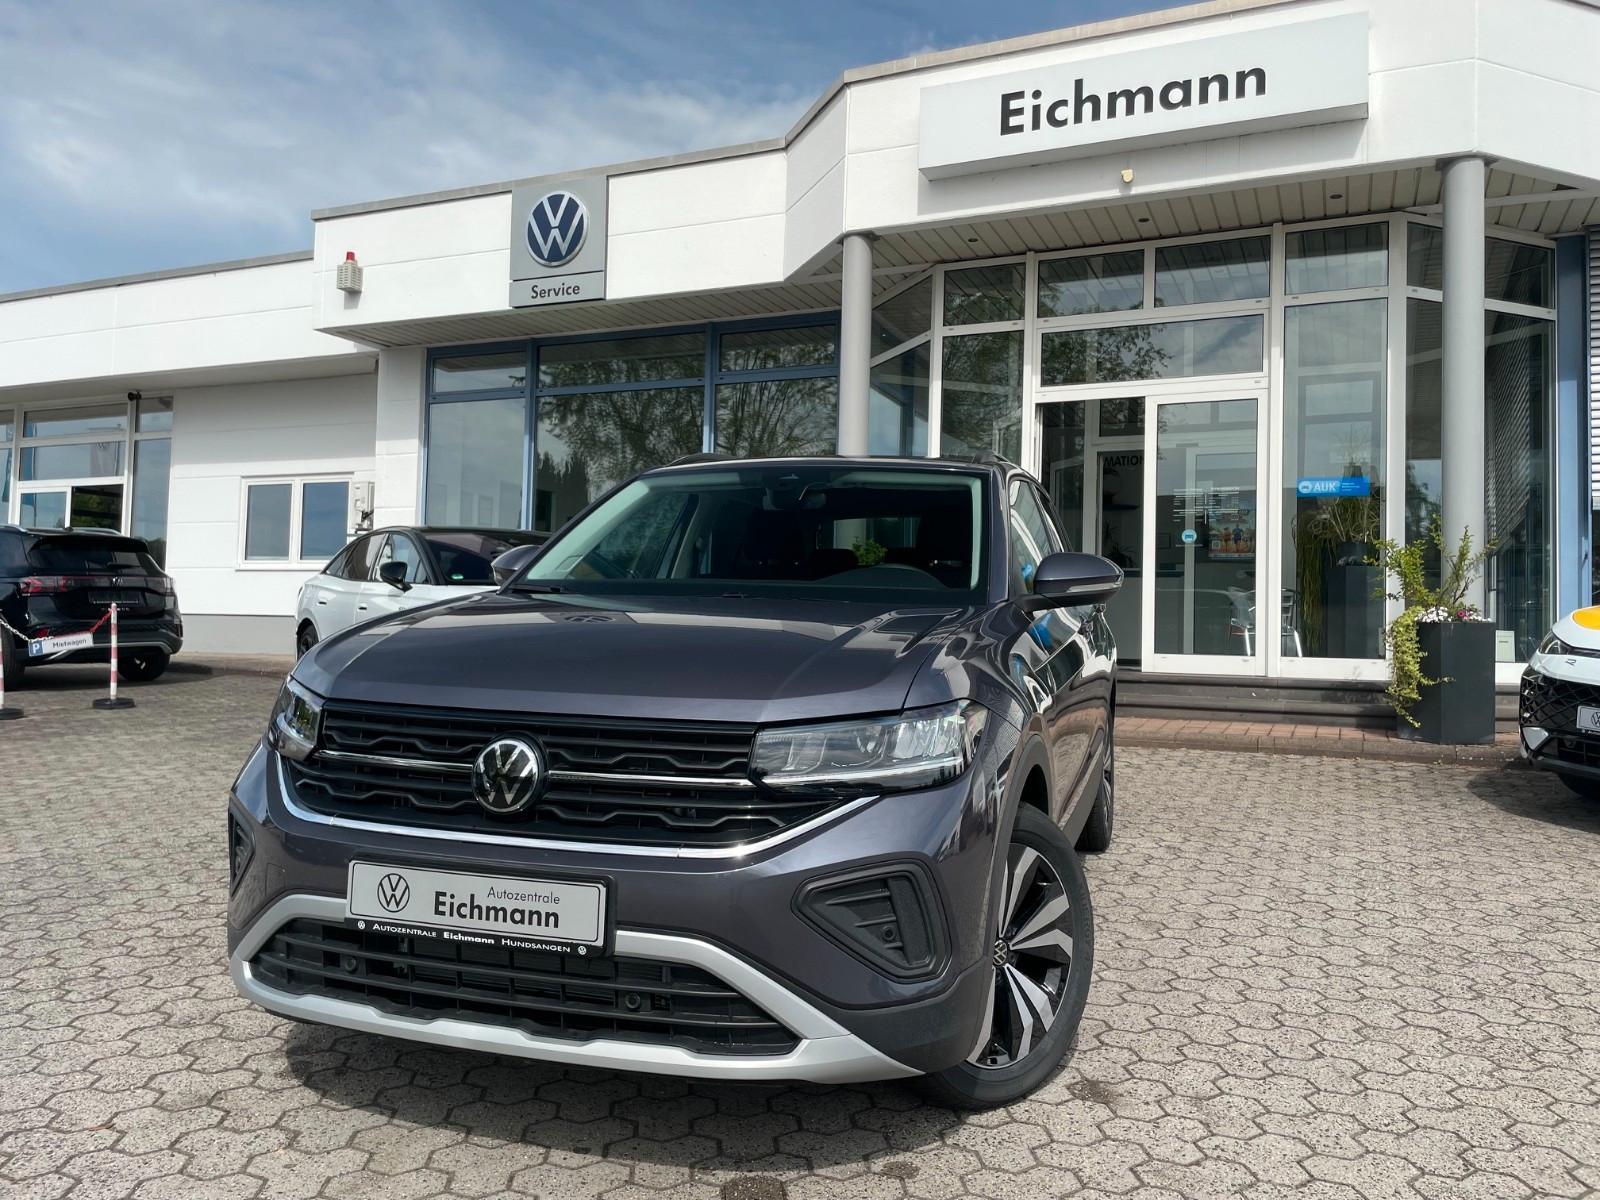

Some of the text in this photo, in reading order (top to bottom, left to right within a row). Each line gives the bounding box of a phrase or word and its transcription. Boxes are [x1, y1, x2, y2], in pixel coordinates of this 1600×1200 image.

[1000, 67, 1266, 136] Eichmann
[531, 282, 581, 299] Service
[1313, 481, 1337, 493] AUK
[32, 643, 40, 654] P
[487, 886, 561, 905] Autozentrale
[434, 891, 560, 929] Eichmann
[443, 931, 495, 945] Eichmann
